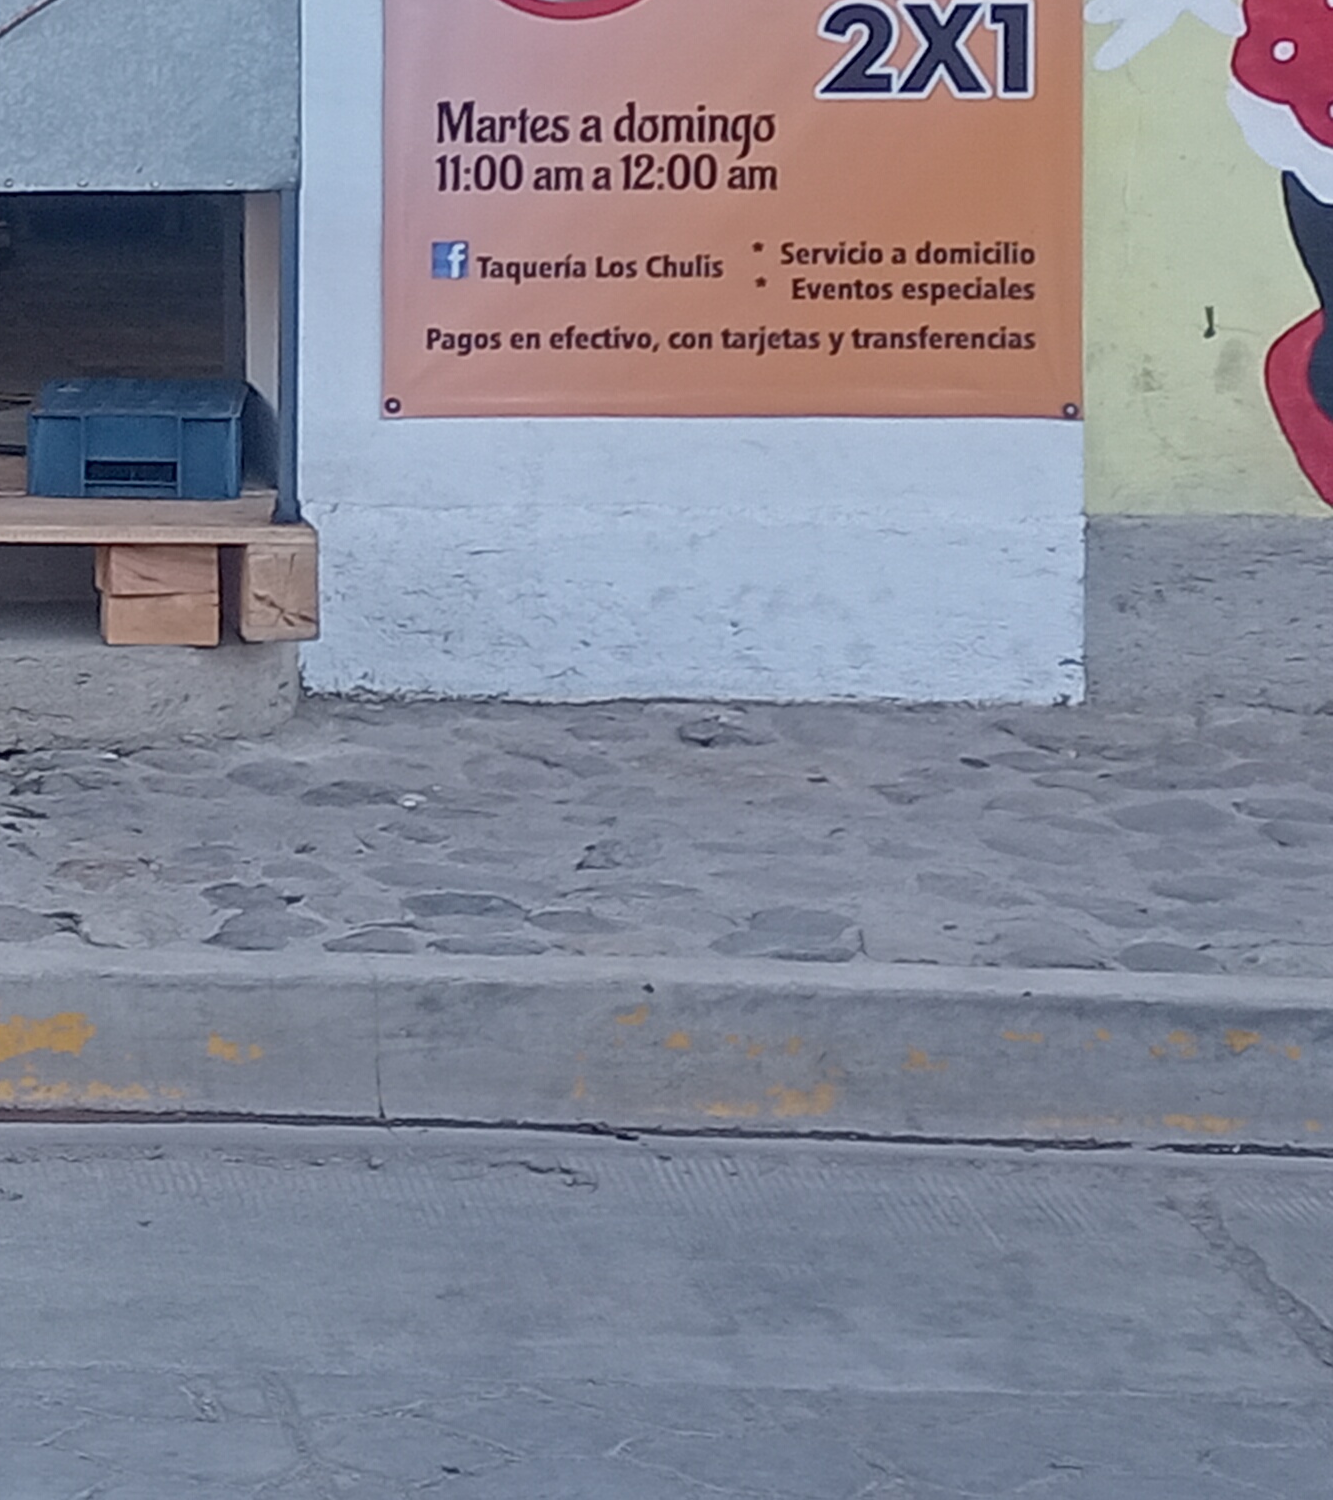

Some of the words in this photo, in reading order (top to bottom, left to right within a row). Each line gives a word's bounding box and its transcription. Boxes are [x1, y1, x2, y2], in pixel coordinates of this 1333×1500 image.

[819, 3, 1031, 94] 2X1
[436, 102, 570, 143] Martes
[580, 114, 603, 143] a
[614, 105, 775, 158] domingo
[436, 153, 524, 191] 11:00
[532, 163, 583, 191] am
[592, 163, 612, 191] a
[621, 154, 717, 191] 12:00
[727, 163, 777, 190] am
[477, 254, 586, 284] Taquería
[596, 256, 637, 279] Los
[646, 254, 724, 279] Chulis
[781, 242, 882, 267] Servicio
[891, 246, 906, 266] a
[915, 241, 1035, 266] domicilio
[791, 278, 893, 301] Eventos
[902, 278, 1035, 305] especiales
[426, 327, 501, 356] Pagos
[511, 331, 541, 350] en
[549, 326, 659, 353] efectivo,
[669, 331, 713, 350] con
[722, 327, 819, 355] tarjetas
[828, 331, 844, 355] y
[852, 325, 1035, 352] transferencias
